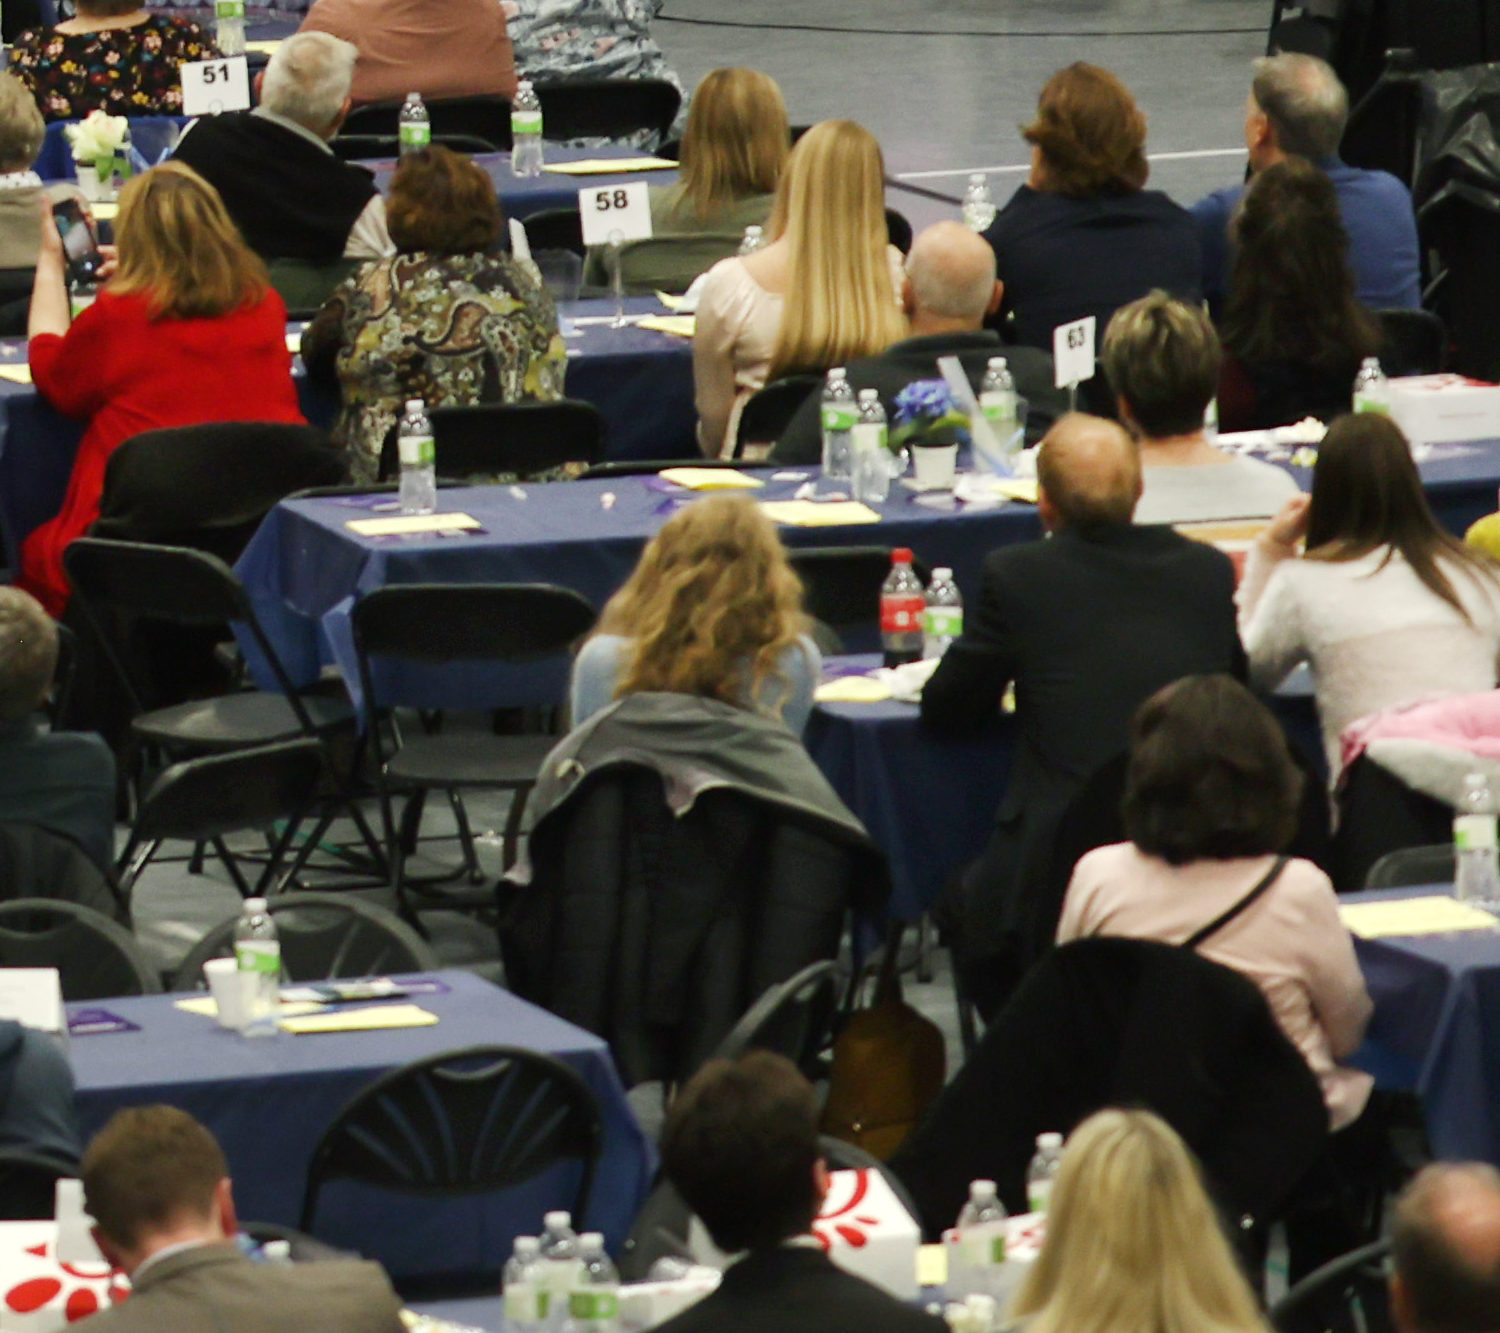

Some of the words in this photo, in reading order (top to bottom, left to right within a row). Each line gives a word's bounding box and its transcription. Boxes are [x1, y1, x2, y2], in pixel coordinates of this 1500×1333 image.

[203, 64, 229, 83] 51
[596, 190, 628, 211] 58
[1067, 326, 1084, 349] 63
